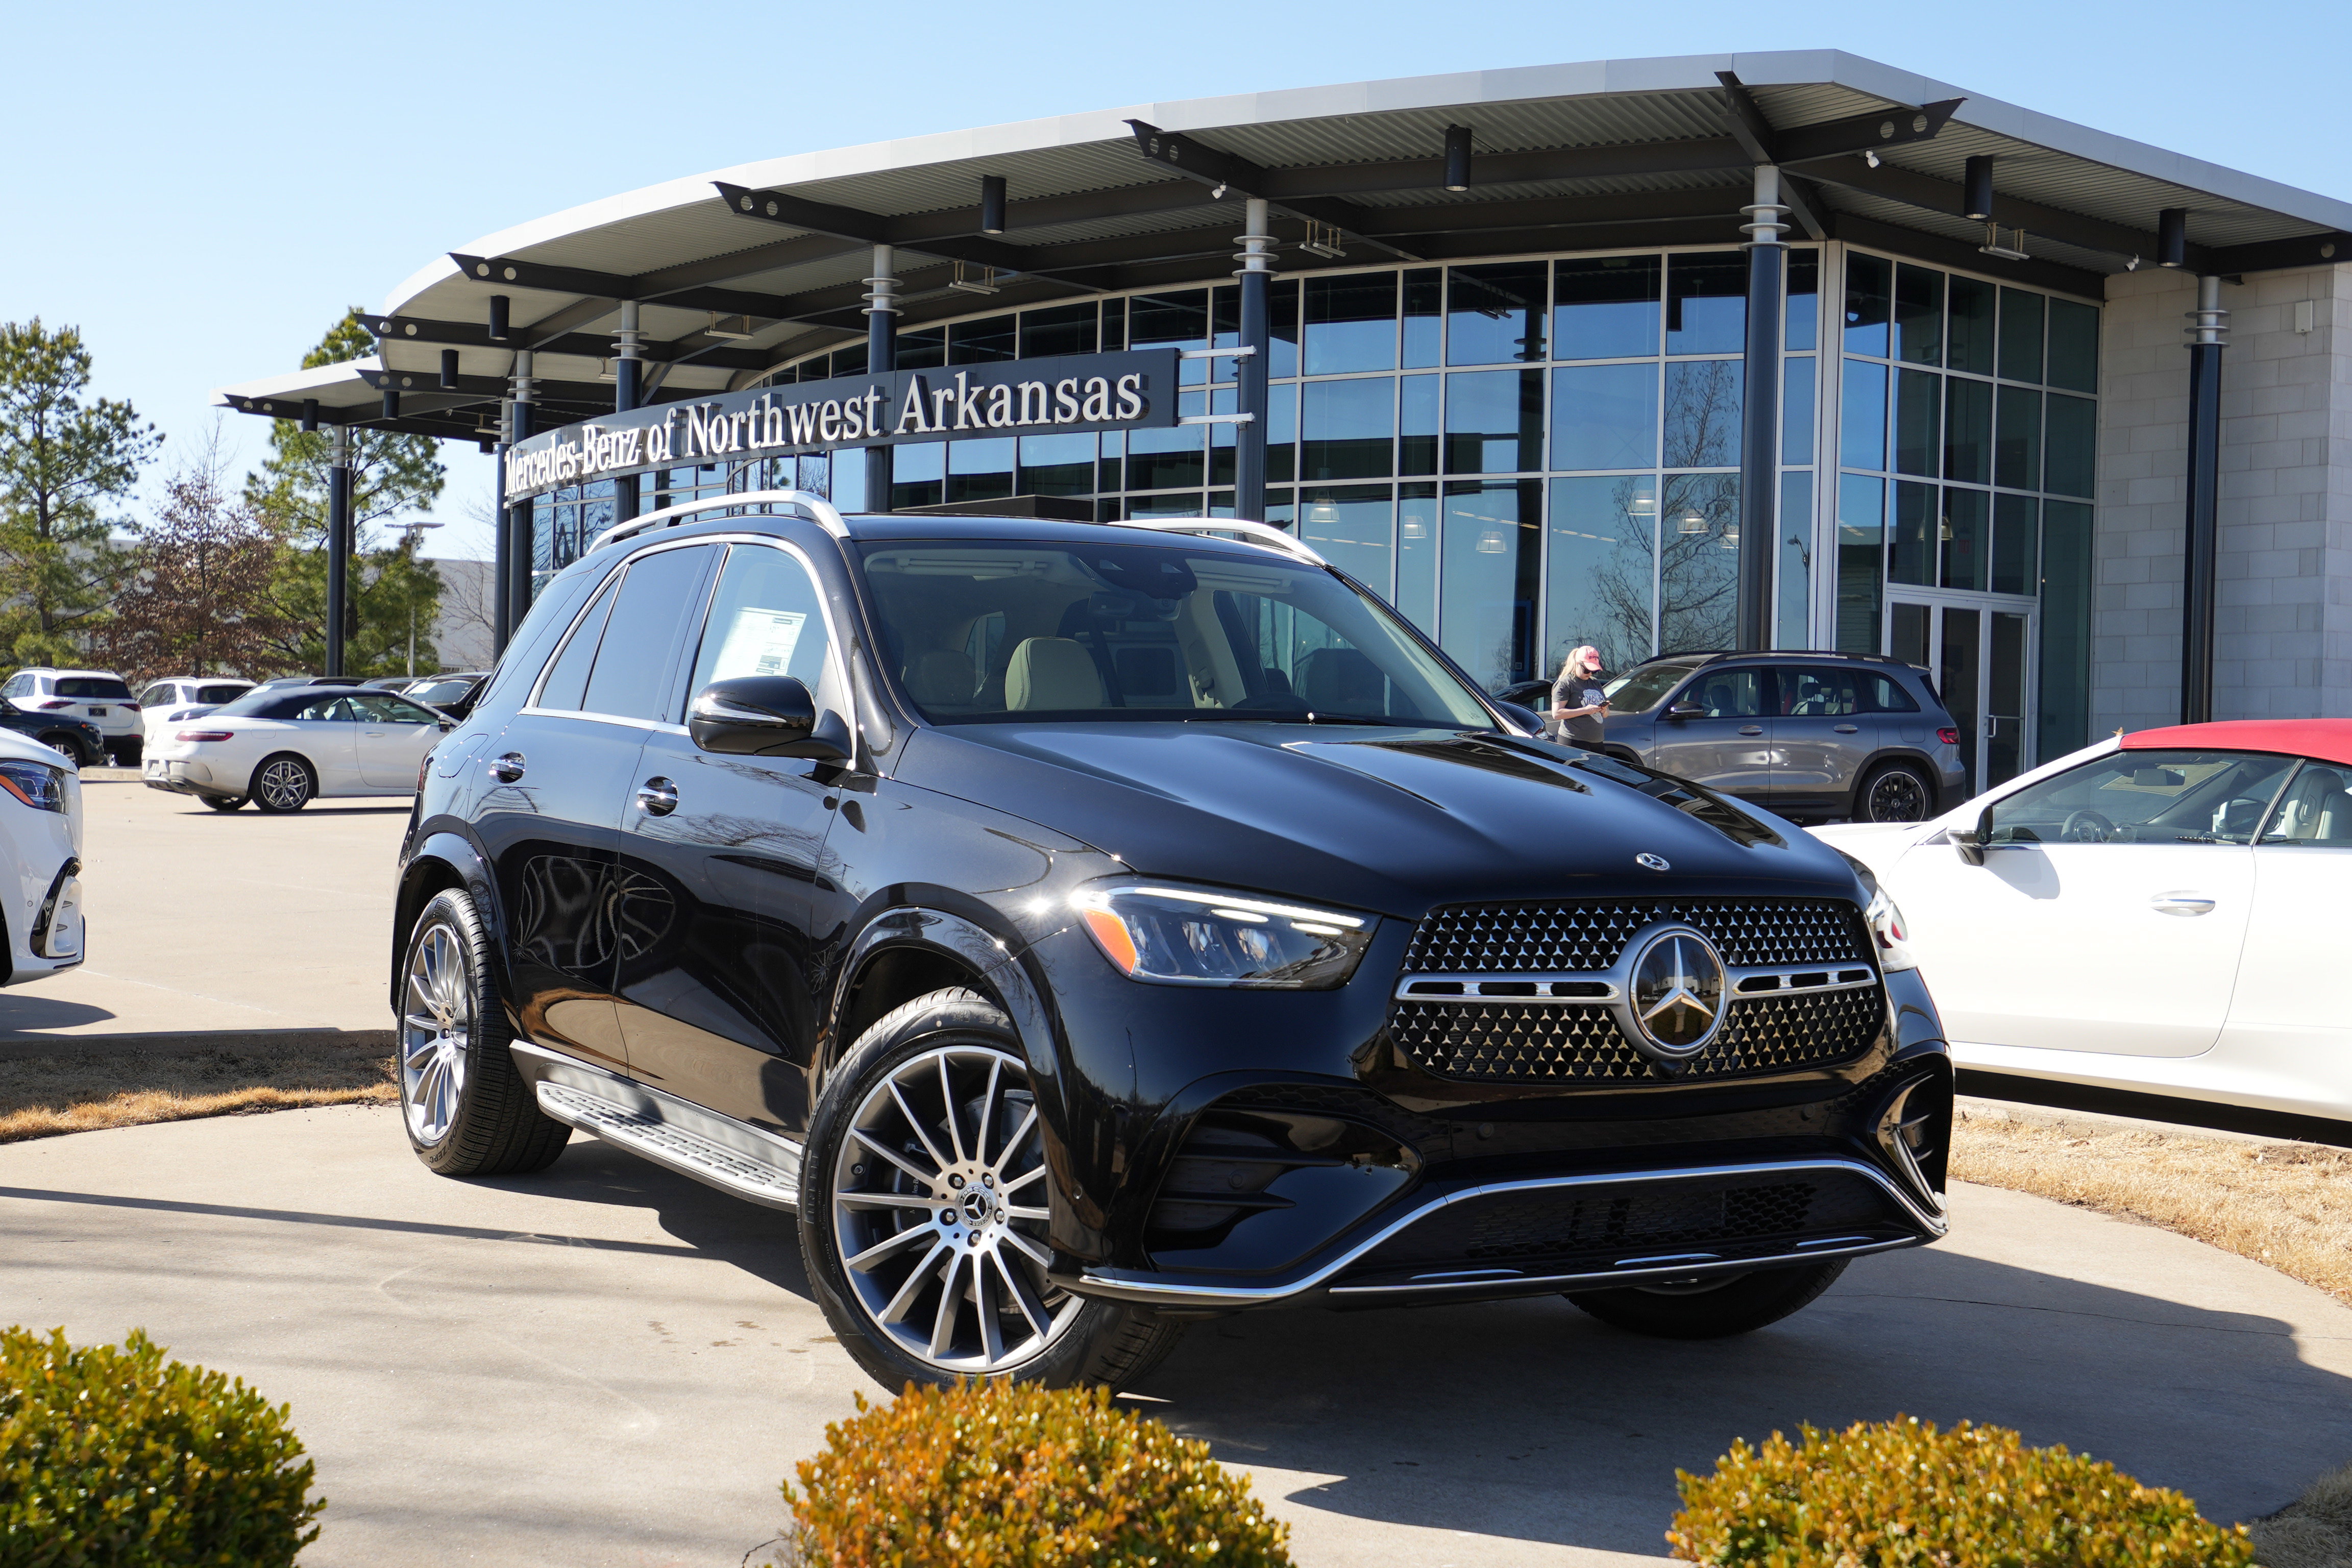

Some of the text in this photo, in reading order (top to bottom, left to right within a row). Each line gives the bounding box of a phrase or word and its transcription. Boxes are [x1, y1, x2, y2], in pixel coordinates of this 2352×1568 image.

[504, 371, 1143, 497] Mercedes-Benz of Northwest Arkansas
